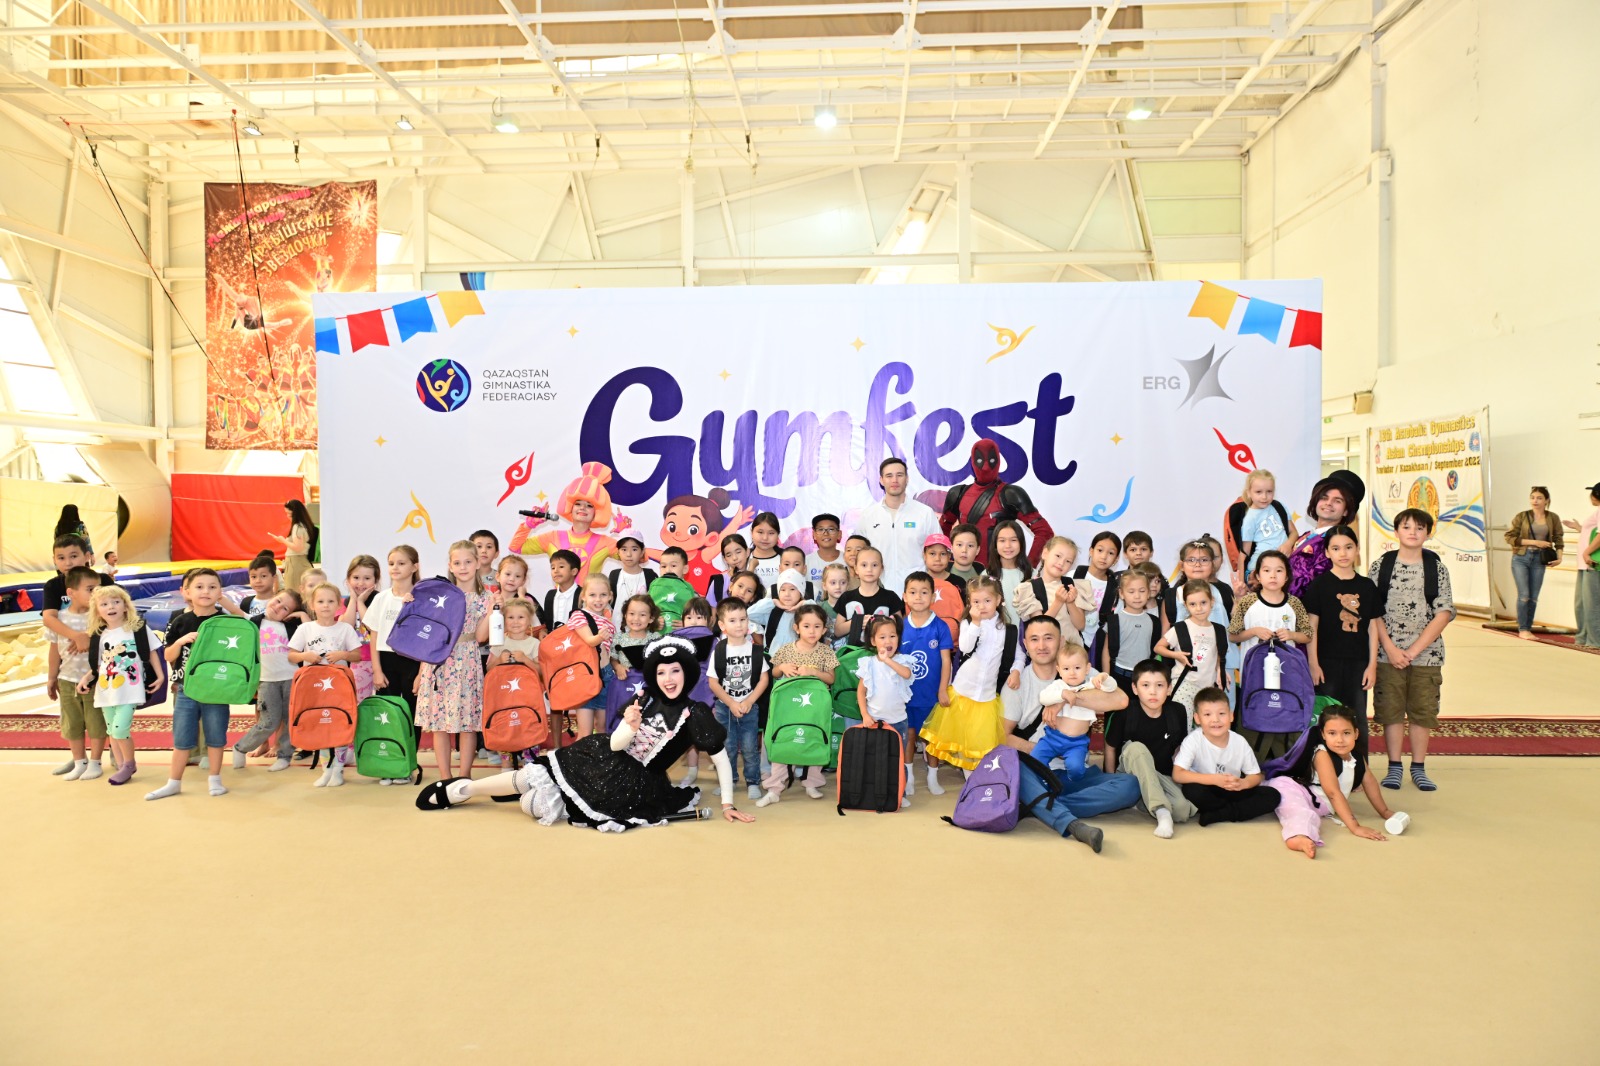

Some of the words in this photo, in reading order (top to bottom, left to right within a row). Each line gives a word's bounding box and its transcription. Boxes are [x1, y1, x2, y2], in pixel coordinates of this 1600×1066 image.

[482, 369, 549, 379] QAZAQSTAN
[482, 381, 551, 390] GIMNASTIKA
[1142, 375, 1181, 390] ERG
[482, 392, 558, 401] FEDERACIASY
[1429, 415, 1476, 437] Gymnastics
[579, 361, 1078, 528] Gymfest
[1407, 438, 1466, 458] Championships
[1434, 459, 1464, 472] September
[1464, 456, 1480, 467] 2022
[1260, 514, 1283, 538] GA
[726, 655, 752, 666] NEXT
